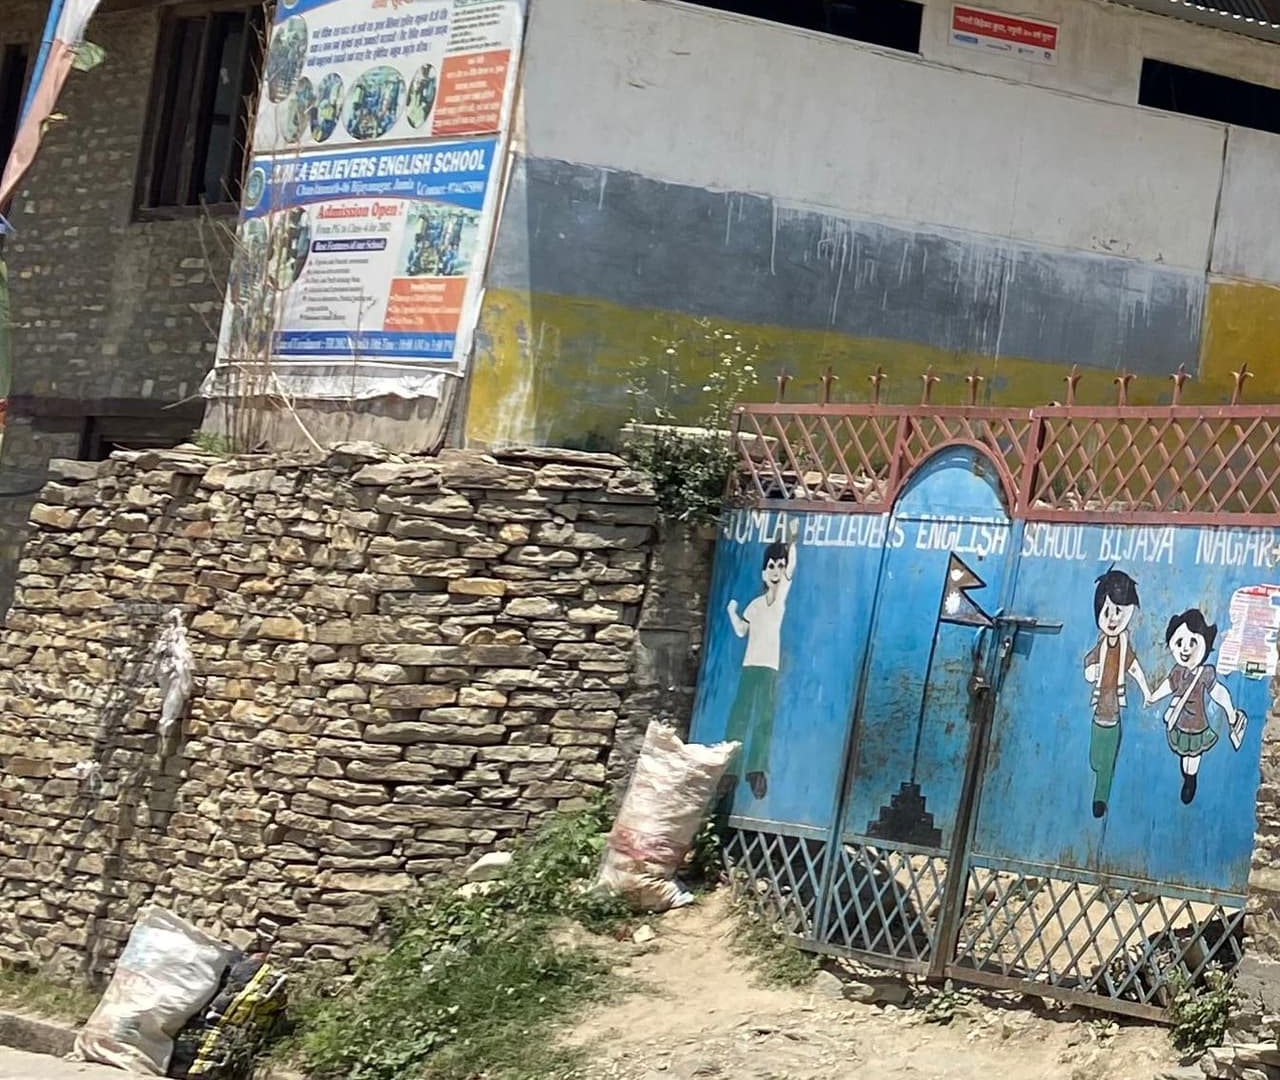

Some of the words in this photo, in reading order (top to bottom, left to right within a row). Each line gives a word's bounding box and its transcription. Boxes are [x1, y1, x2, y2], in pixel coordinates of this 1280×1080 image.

[308, 156, 377, 181] BELIEVERS
[377, 152, 433, 177] ENGLISH
[433, 148, 486, 174] SCHOOL
[315, 203, 369, 219] Admission
[371, 201, 397, 221] Open
[725, 510, 787, 544] JUMLA
[915, 514, 1009, 555] ENGLISH
[1021, 521, 1088, 560] SCHOOL
[1099, 524, 1176, 564] BIJAYA
